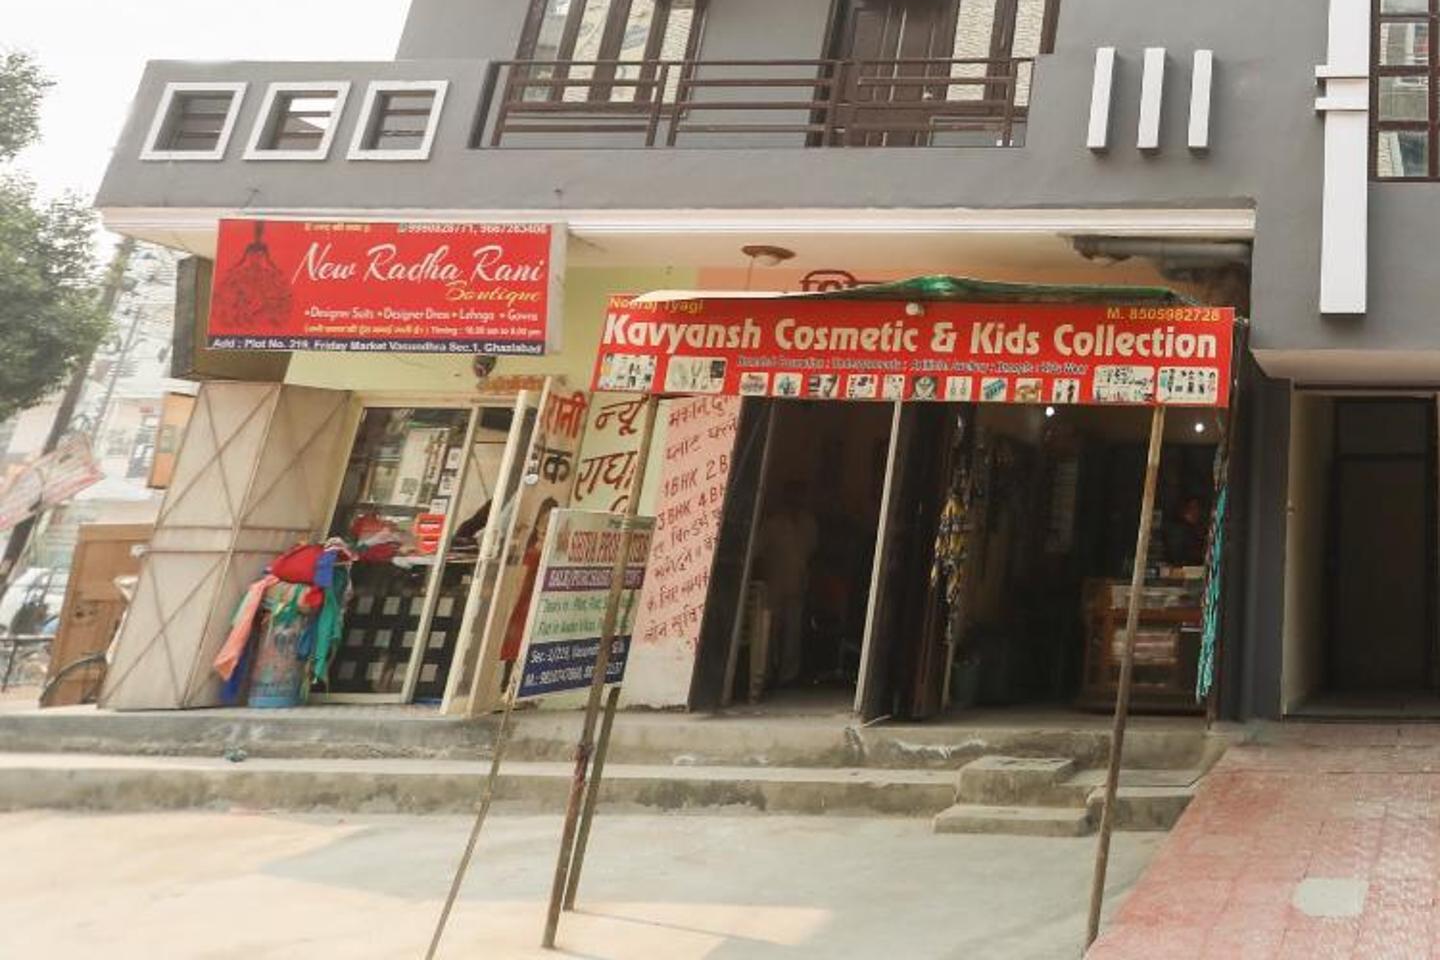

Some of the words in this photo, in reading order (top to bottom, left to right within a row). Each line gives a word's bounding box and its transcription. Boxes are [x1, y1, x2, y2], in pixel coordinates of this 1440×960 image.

[291, 241, 357, 285] New
[363, 243, 464, 283] Radha
[470, 244, 545, 283] Rani
[445, 280, 541, 307] Boutique
[602, 312, 761, 354] Kavyansh
[774, 318, 919, 352] Cosmetic
[930, 321, 958, 353] &
[970, 321, 1041, 355] Kids
[1054, 323, 1217, 358] Collection
